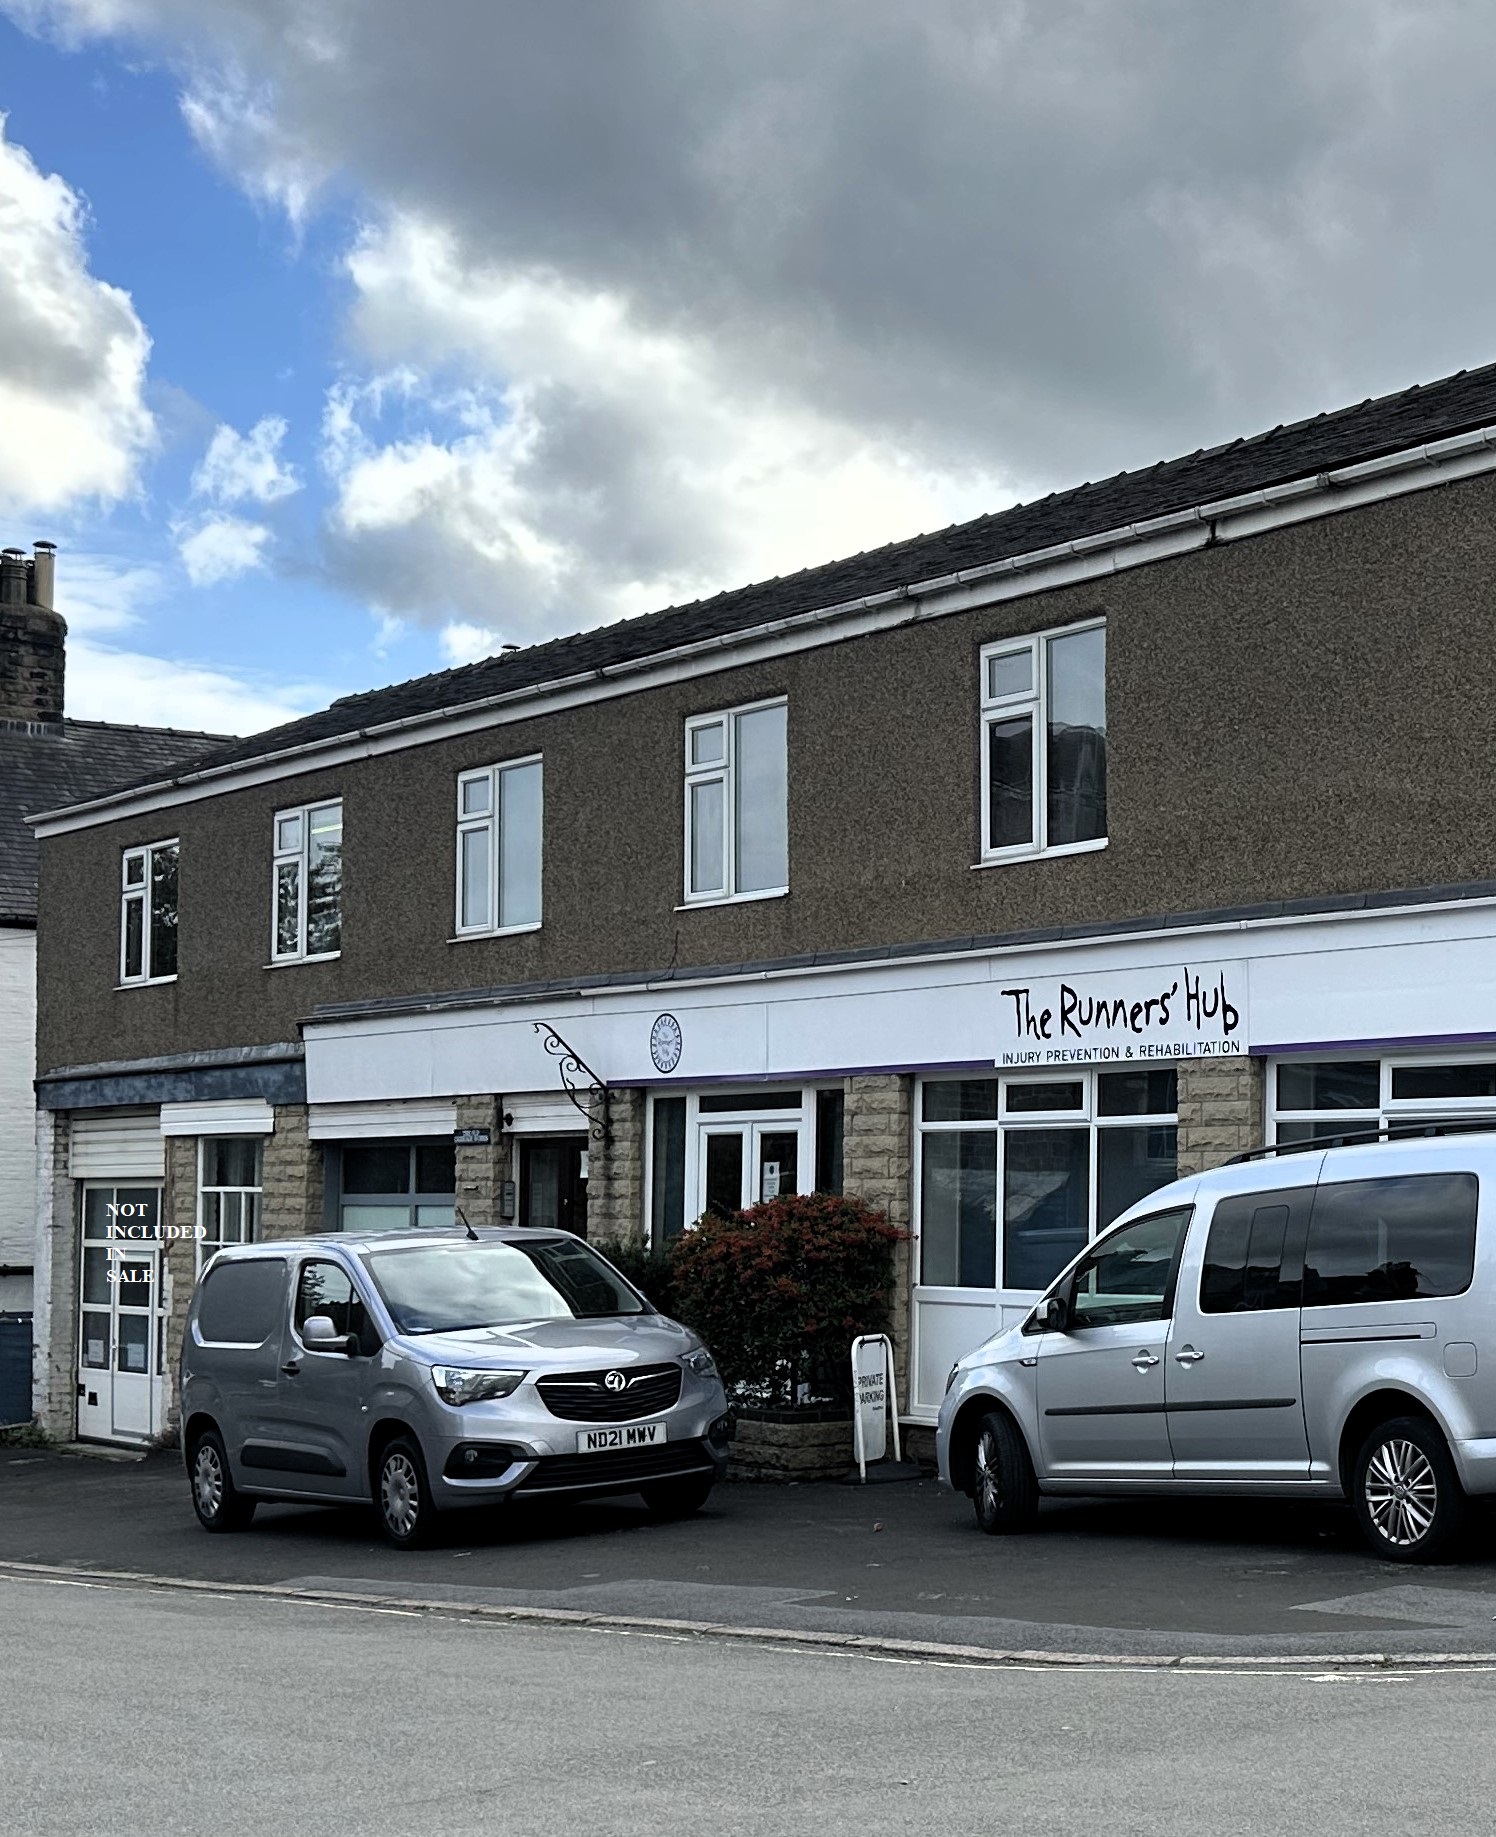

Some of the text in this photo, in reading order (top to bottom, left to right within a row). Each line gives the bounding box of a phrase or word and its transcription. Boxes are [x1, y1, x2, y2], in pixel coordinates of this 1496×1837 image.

[1000, 988, 1052, 1040] The
[1184, 966, 1239, 1036] Hub
[1002, 1040, 1240, 1064] INJURY PREVENTION & REHABILITATION
[858, 1390, 885, 1404] ARKING
[587, 1426, 656, 1449] ND21 MWV
